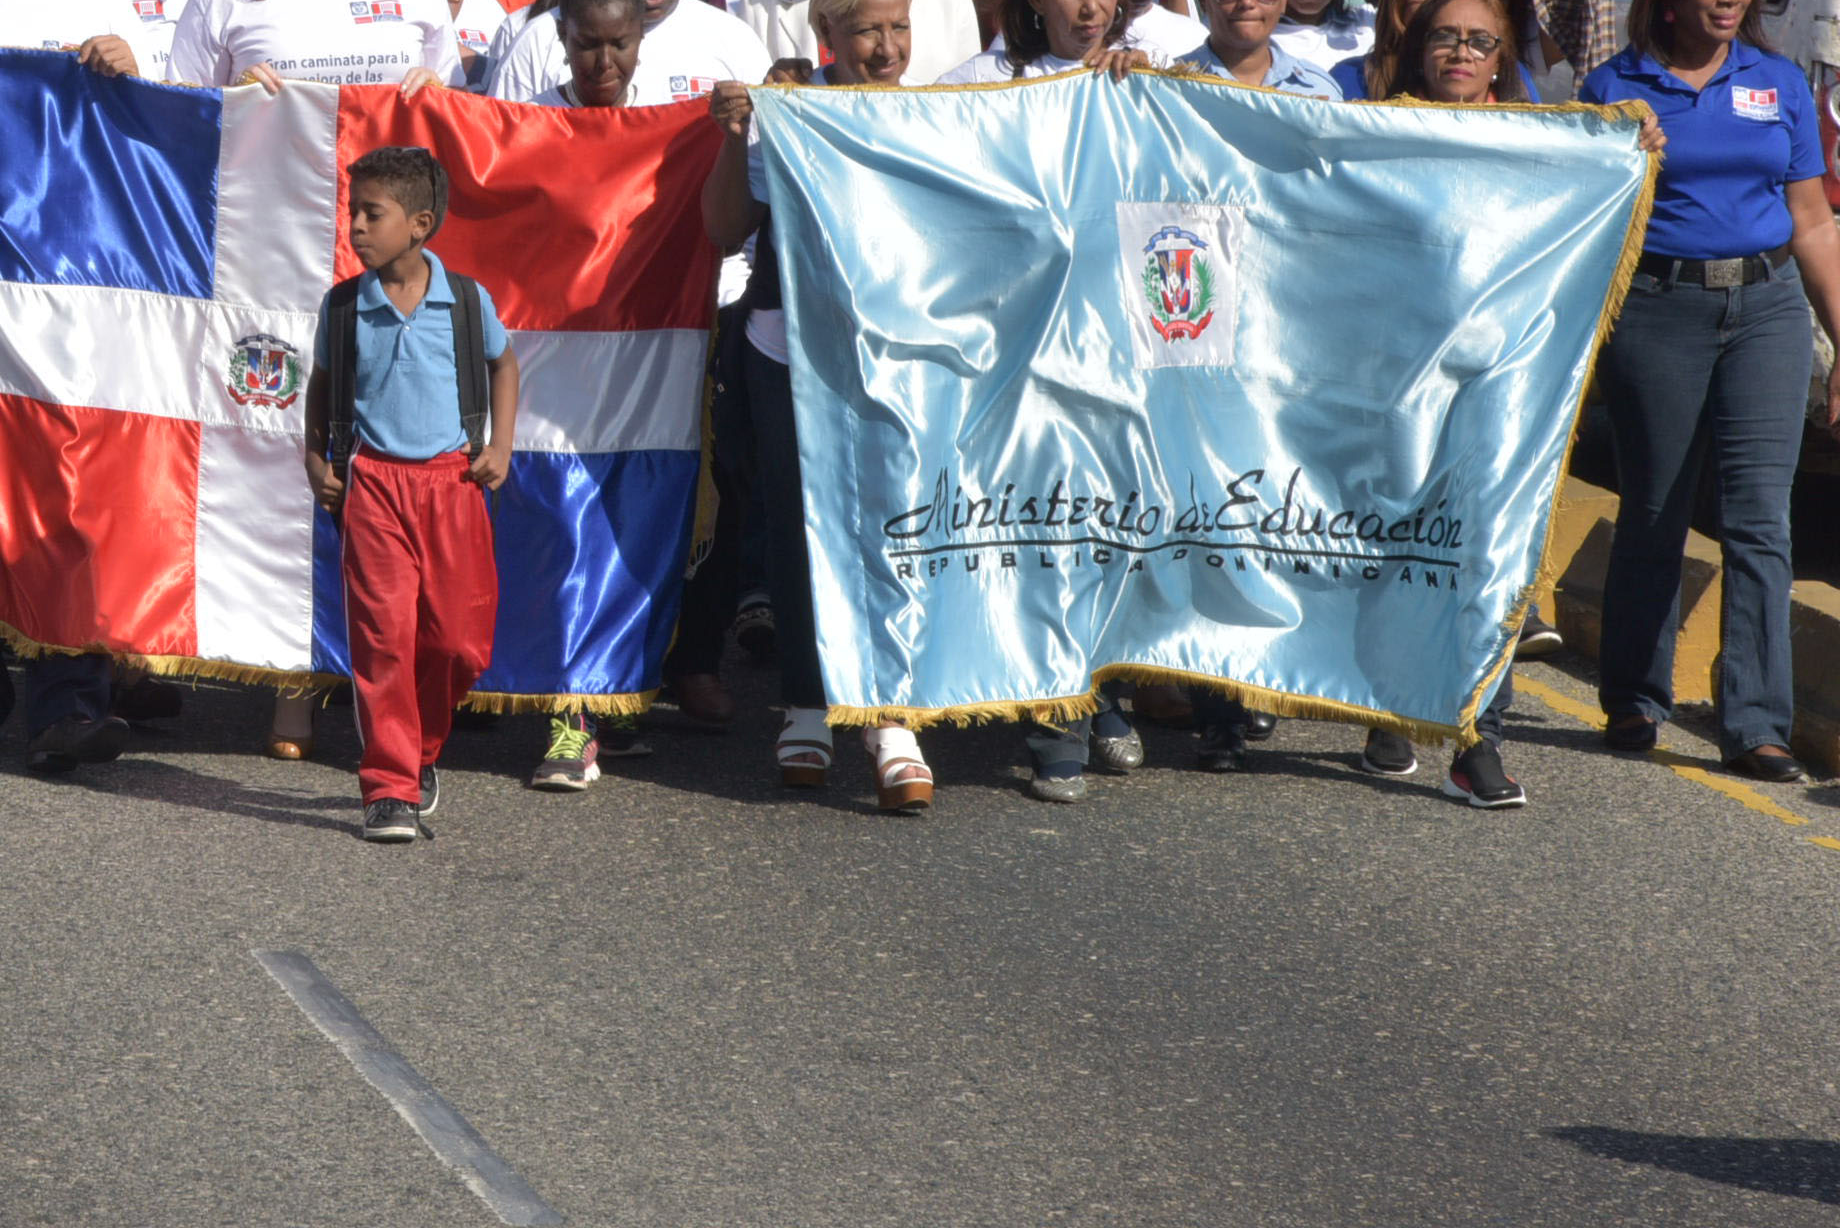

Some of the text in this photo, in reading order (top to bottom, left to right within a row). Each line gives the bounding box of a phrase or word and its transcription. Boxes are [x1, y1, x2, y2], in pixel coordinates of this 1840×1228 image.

[301, 54, 364, 69] caminata
[368, 53, 398, 68] para
[401, 50, 410, 64] la
[346, 71, 361, 84] de
[365, 70, 383, 83] las
[883, 466, 1463, 549] Ministerio de Educación
[896, 549, 1458, 590] REPUBLICA DOMINICANA
